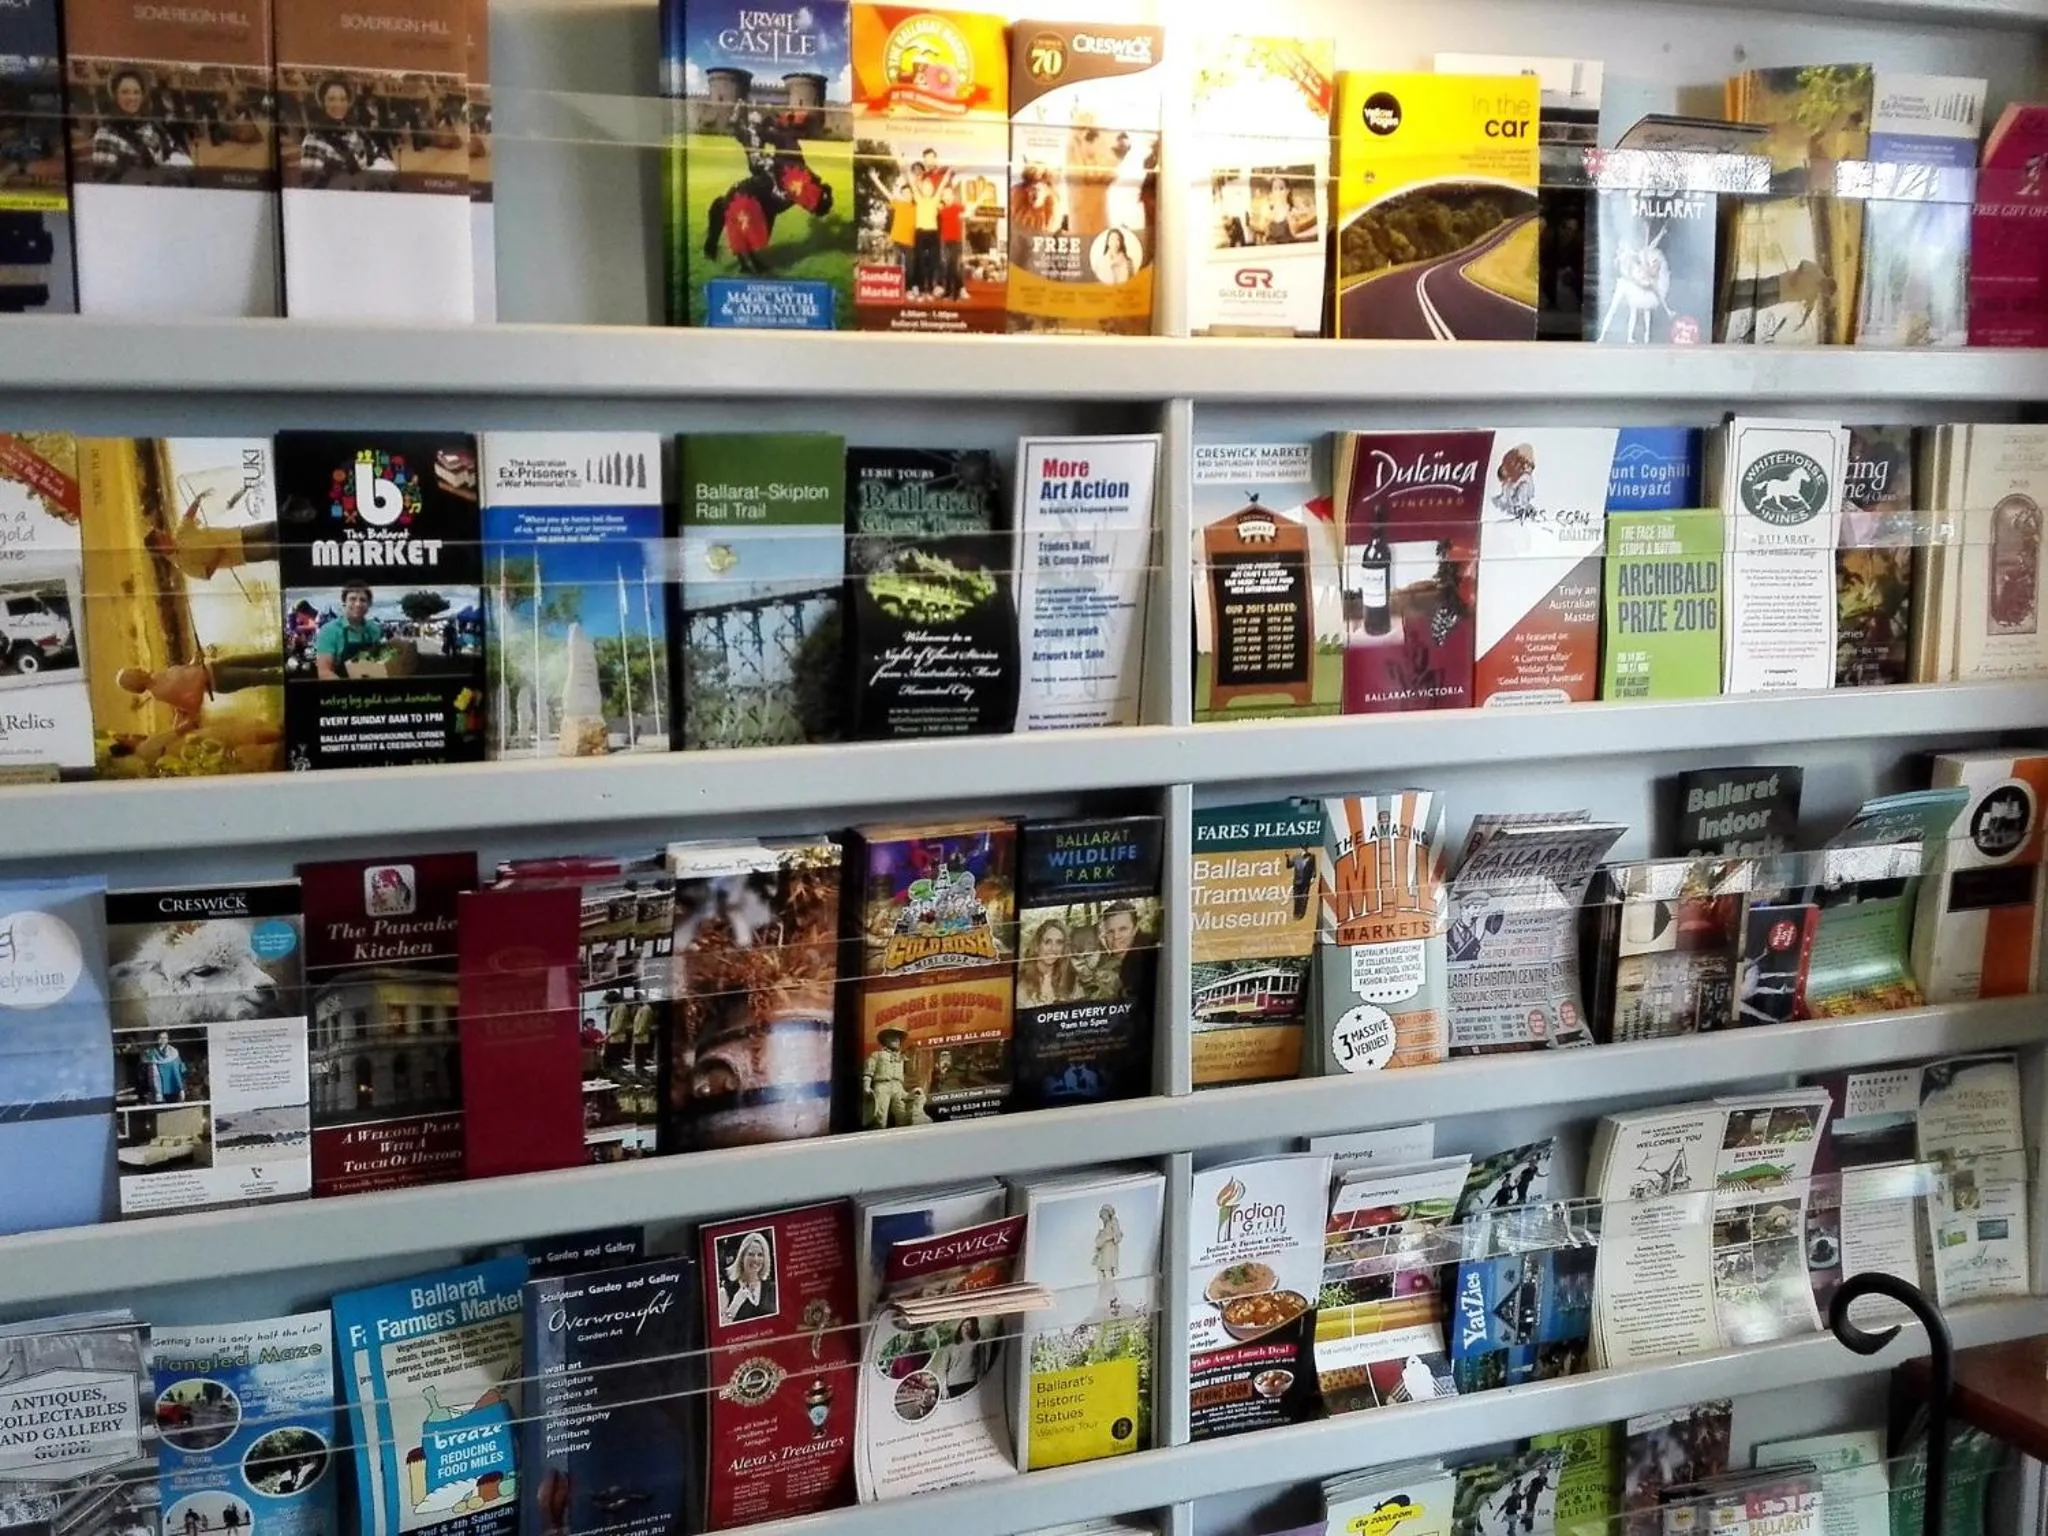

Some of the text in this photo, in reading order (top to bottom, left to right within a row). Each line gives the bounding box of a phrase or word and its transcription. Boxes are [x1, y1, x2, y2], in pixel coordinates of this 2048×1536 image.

[133, 6, 250, 26] SOVEREIGN HILL
[341, 13, 450, 35] SOVEREIGN HILL
[719, 29, 816, 64] CASTLE
[1072, 33, 1152, 55] CRESWICK
[1032, 48, 1062, 76] 70
[1497, 93, 1531, 116] the
[1485, 119, 1530, 139] car
[1631, 199, 1707, 219] BALLARAT
[1973, 203, 2024, 217] FREE GIFT
[1032, 236, 1081, 253] FREE
[860, 269, 901, 283] Sunday
[860, 284, 901, 298] Market
[510, 459, 524, 467] The
[1197, 447, 1310, 459] CRESWICK MARKET
[499, 467, 577, 479] Ex-Prisoners
[898, 468, 935, 480] TOURS
[1042, 458, 1091, 478] More
[1612, 464, 1690, 480] unt Coghill
[1744, 453, 1826, 486] WHITEHORSE
[1040, 479, 1129, 500] Art Action
[1609, 481, 1672, 498] Vineyard
[696, 501, 767, 519] Rail Trail
[1759, 508, 1810, 526] WINES
[1757, 533, 1810, 546] BALLARAT
[312, 539, 443, 567] MARKET
[1082, 554, 1110, 565] Street
[1617, 562, 1718, 598] ARCHIBALD
[1559, 585, 1597, 599] Truly an
[1549, 598, 1596, 610] Australian
[1564, 612, 1595, 623] Master
[1617, 598, 1668, 644] PRIZE
[1673, 598, 1718, 631] 2016
[1066, 626, 1099, 637] at work
[1032, 649, 1105, 661] Artwork for Sale
[1365, 687, 1465, 703] BALLARAT VICTORIA
[6, 712, 56, 732] Relics
[350, 715, 385, 726] SUNDAY
[411, 713, 422, 723] TO
[1687, 774, 1780, 813] Ballarat
[1197, 820, 1321, 841] FARES PLEASE!
[1698, 808, 1771, 841] Indoor
[1056, 829, 1130, 848] BALLARAT
[1334, 823, 1430, 857] THE AMAZING
[1048, 845, 1137, 867] WILDLIFE
[1066, 864, 1116, 881] PARK
[1194, 857, 1281, 880] Ballarat
[158, 895, 247, 914] CRESWICK
[1191, 883, 1294, 906] Tramway
[327, 915, 458, 941] The Pancake
[1191, 909, 1287, 931] Museum
[1343, 920, 1431, 942] MARKETS
[353, 940, 434, 961] Kitchen
[889, 934, 990, 966] GOLDRUSH
[1037, 1003, 1133, 1024] OPEN EVERY DAY
[1060, 1019, 1109, 1030] 9am to 5pm
[928, 1032, 979, 1045] FUN FOR ALL
[1338, 1019, 1390, 1061] 3 MASSIVE
[1354, 1033, 1390, 1057] VENUES!
[342, 1126, 420, 1144] A WELCOME
[1637, 1133, 1703, 1149] WELCOMES YOU
[379, 1140, 415, 1154] WITH
[343, 1155, 410, 1173] TOUCH OF
[1242, 1218, 1285, 1233] Grill
[547, 1241, 637, 1261] Garden and Gallery
[902, 1228, 1011, 1268] CRESWICK
[410, 1275, 486, 1310] Ballarat
[540, 1272, 680, 1304] Sculpture Garden and Gallery
[377, 1289, 523, 1342] Farmers Market
[547, 1289, 674, 1336] Overwrought
[153, 1328, 299, 1350] Getting lost is only half the
[577, 1328, 623, 1342] Garden Art
[153, 1342, 323, 1374] Tangled Maze
[219, 1344, 249, 1354] at the
[544, 1361, 582, 1375] wall art
[584, 1387, 599, 1396] art
[1036, 1373, 1095, 1394] Ballarat's
[10, 1387, 108, 1412] ANTIQUES,
[1036, 1392, 1086, 1408] Historic
[546, 1411, 611, 1431] photography
[1035, 1407, 1084, 1425] Statues
[1078, 1419, 1100, 1431] Tour
[43, 1418, 123, 1442] GALLERY
[434, 1423, 502, 1451] breaze
[546, 1428, 590, 1443] furniture
[34, 1439, 92, 1461] GUIDE
[439, 1440, 497, 1466] REDUCING
[546, 1441, 592, 1458] jewellery
[728, 1436, 846, 1473] Alexa's Treasures
[437, 1451, 504, 1480] FOOD MILES
[452, 1506, 514, 1529] 4th Saturday
